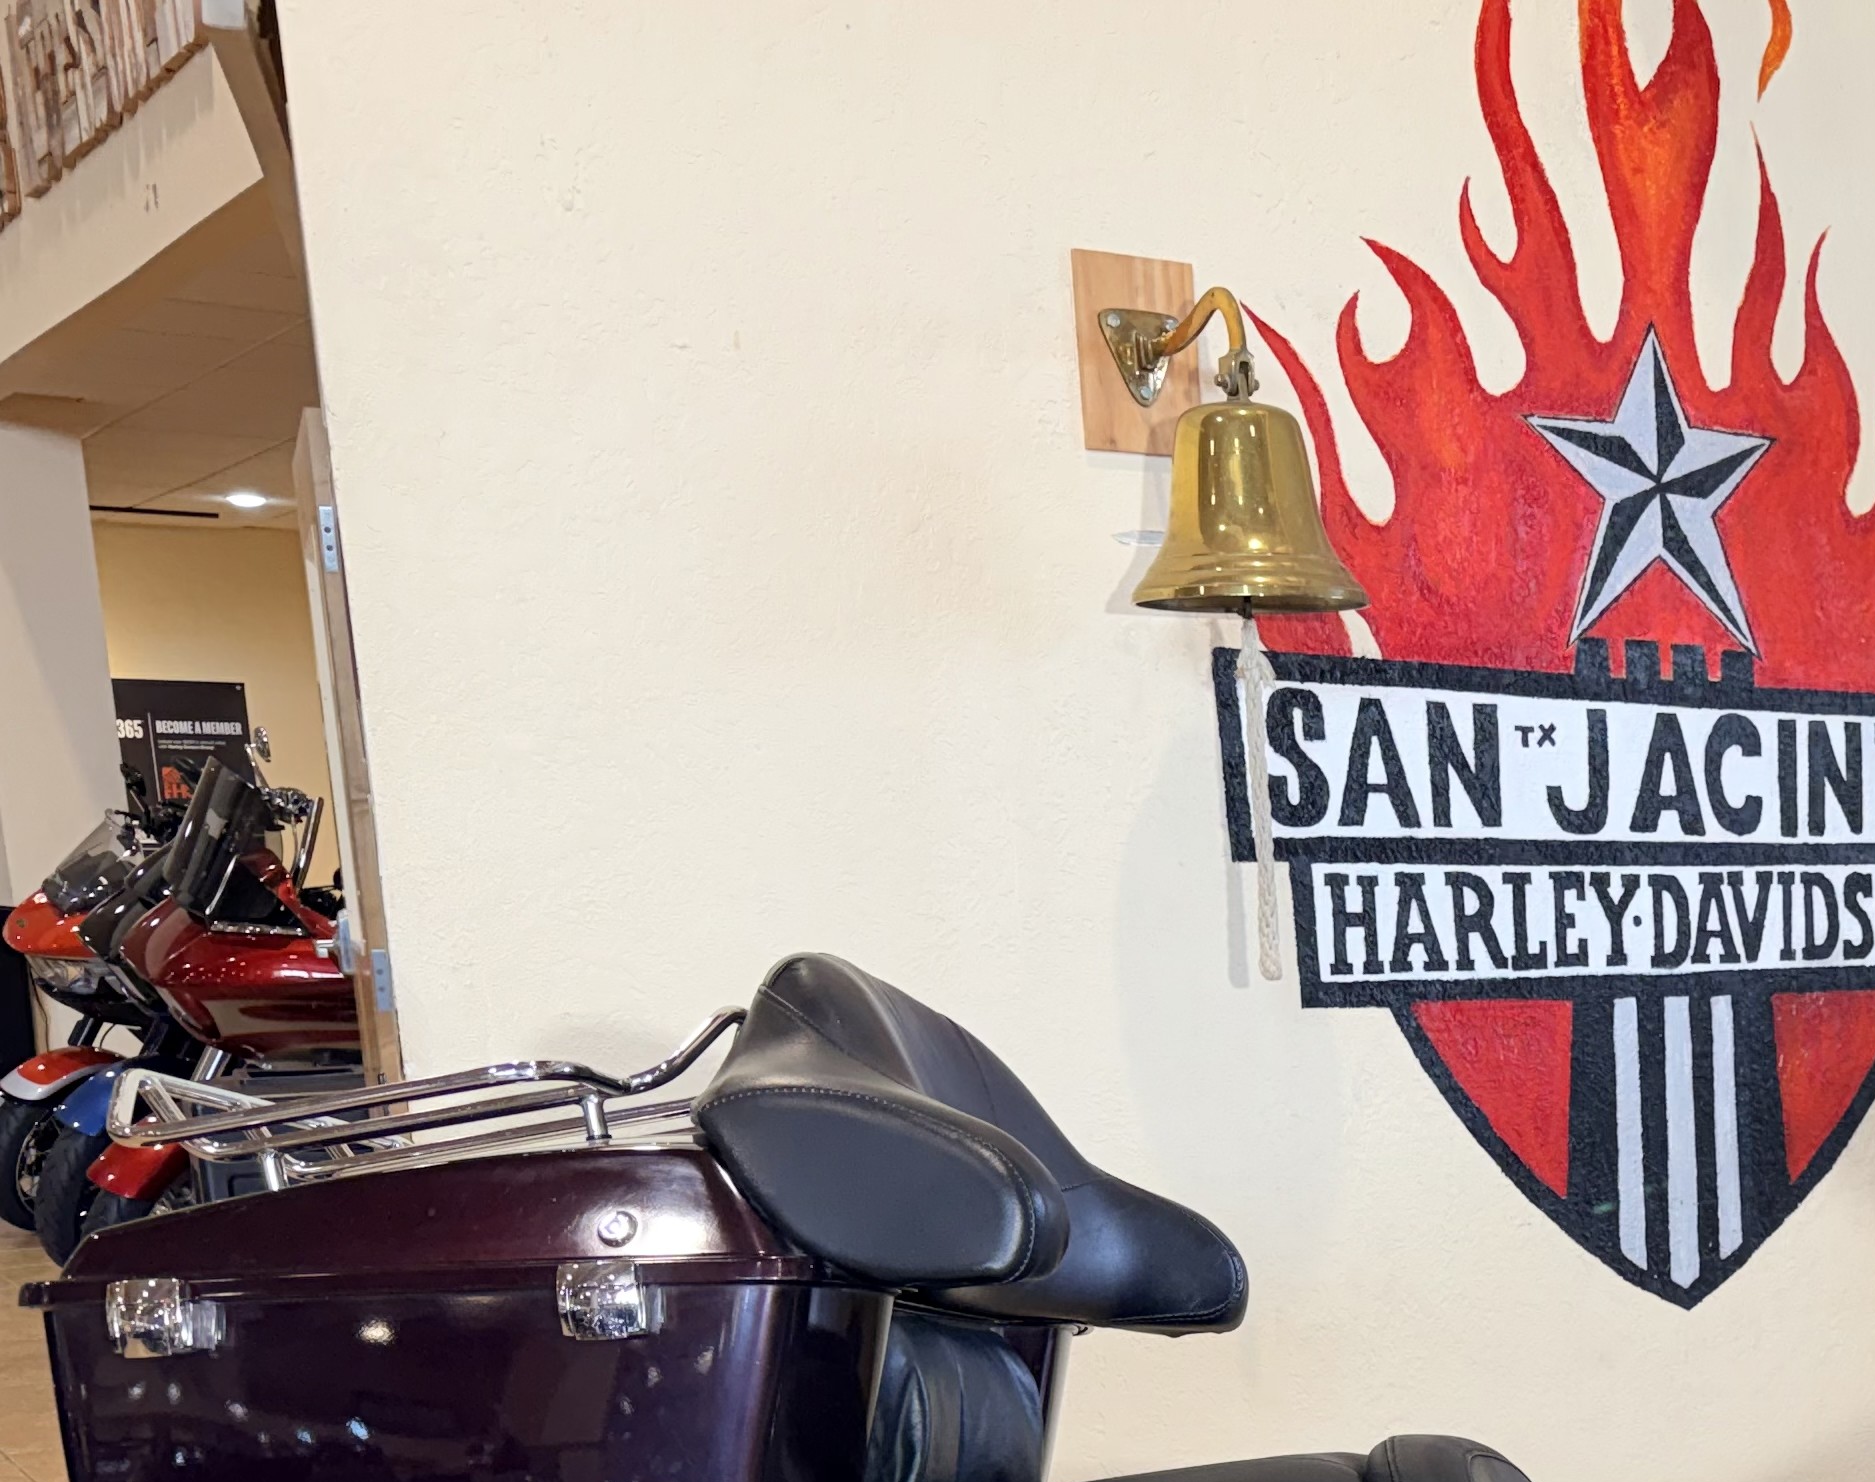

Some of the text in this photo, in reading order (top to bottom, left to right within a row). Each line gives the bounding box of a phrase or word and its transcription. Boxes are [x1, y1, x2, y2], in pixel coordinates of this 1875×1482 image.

[116, 719, 144, 739] 365
[155, 720, 243, 736] BECOME A MEMBER
[1267, 686, 1502, 829] SAN
[1514, 724, 1557, 748] TX
